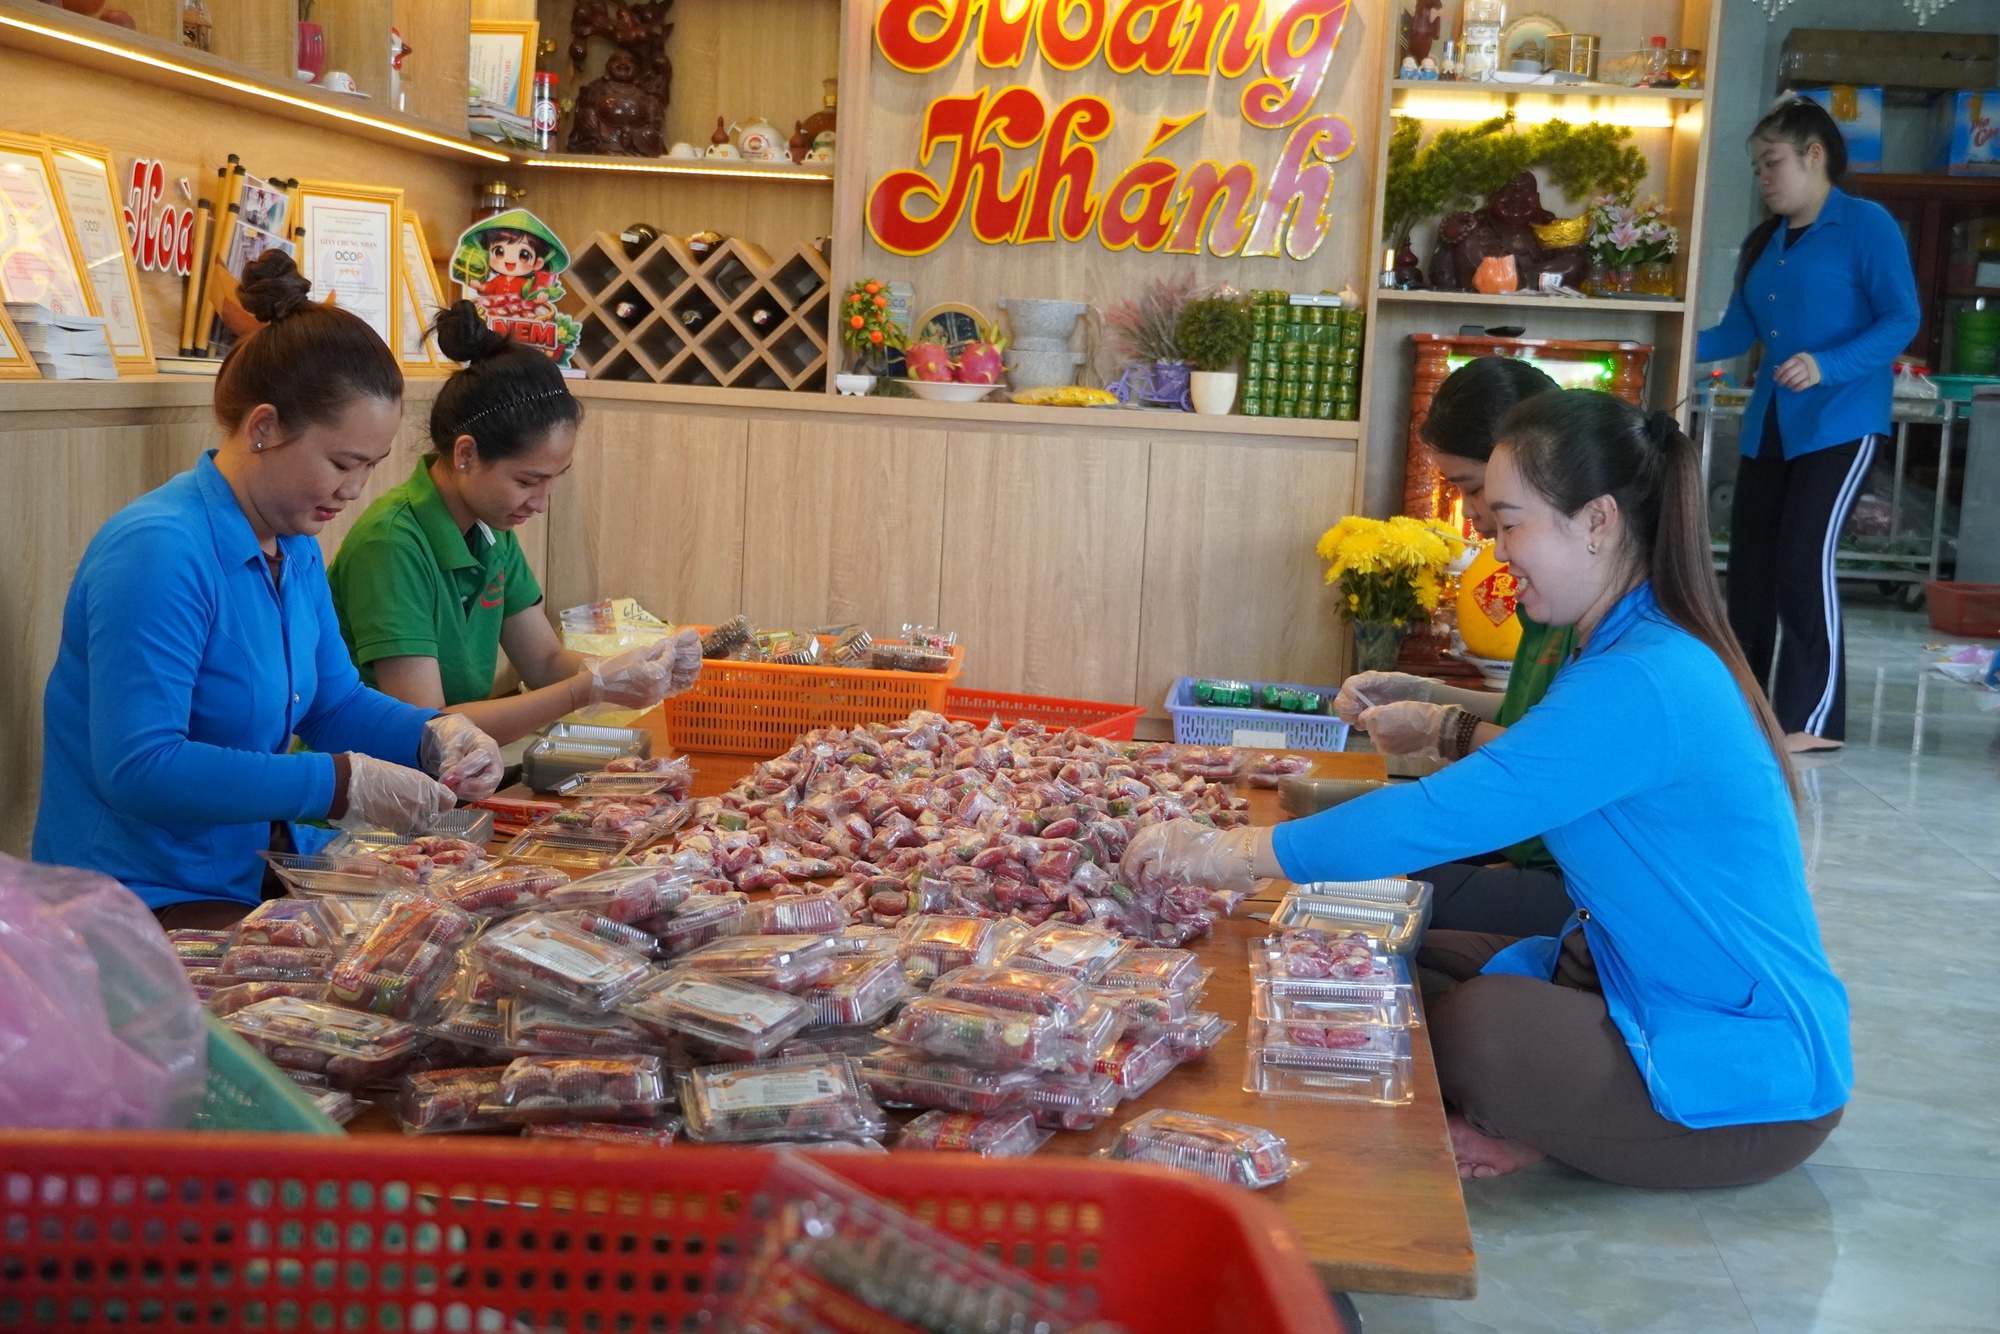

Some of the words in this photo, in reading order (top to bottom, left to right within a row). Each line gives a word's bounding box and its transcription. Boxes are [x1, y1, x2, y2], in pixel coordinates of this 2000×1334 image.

[865, 86, 1357, 261] Khánh
[335, 250, 363, 262] OCOP
[492, 319, 555, 347] NEM
